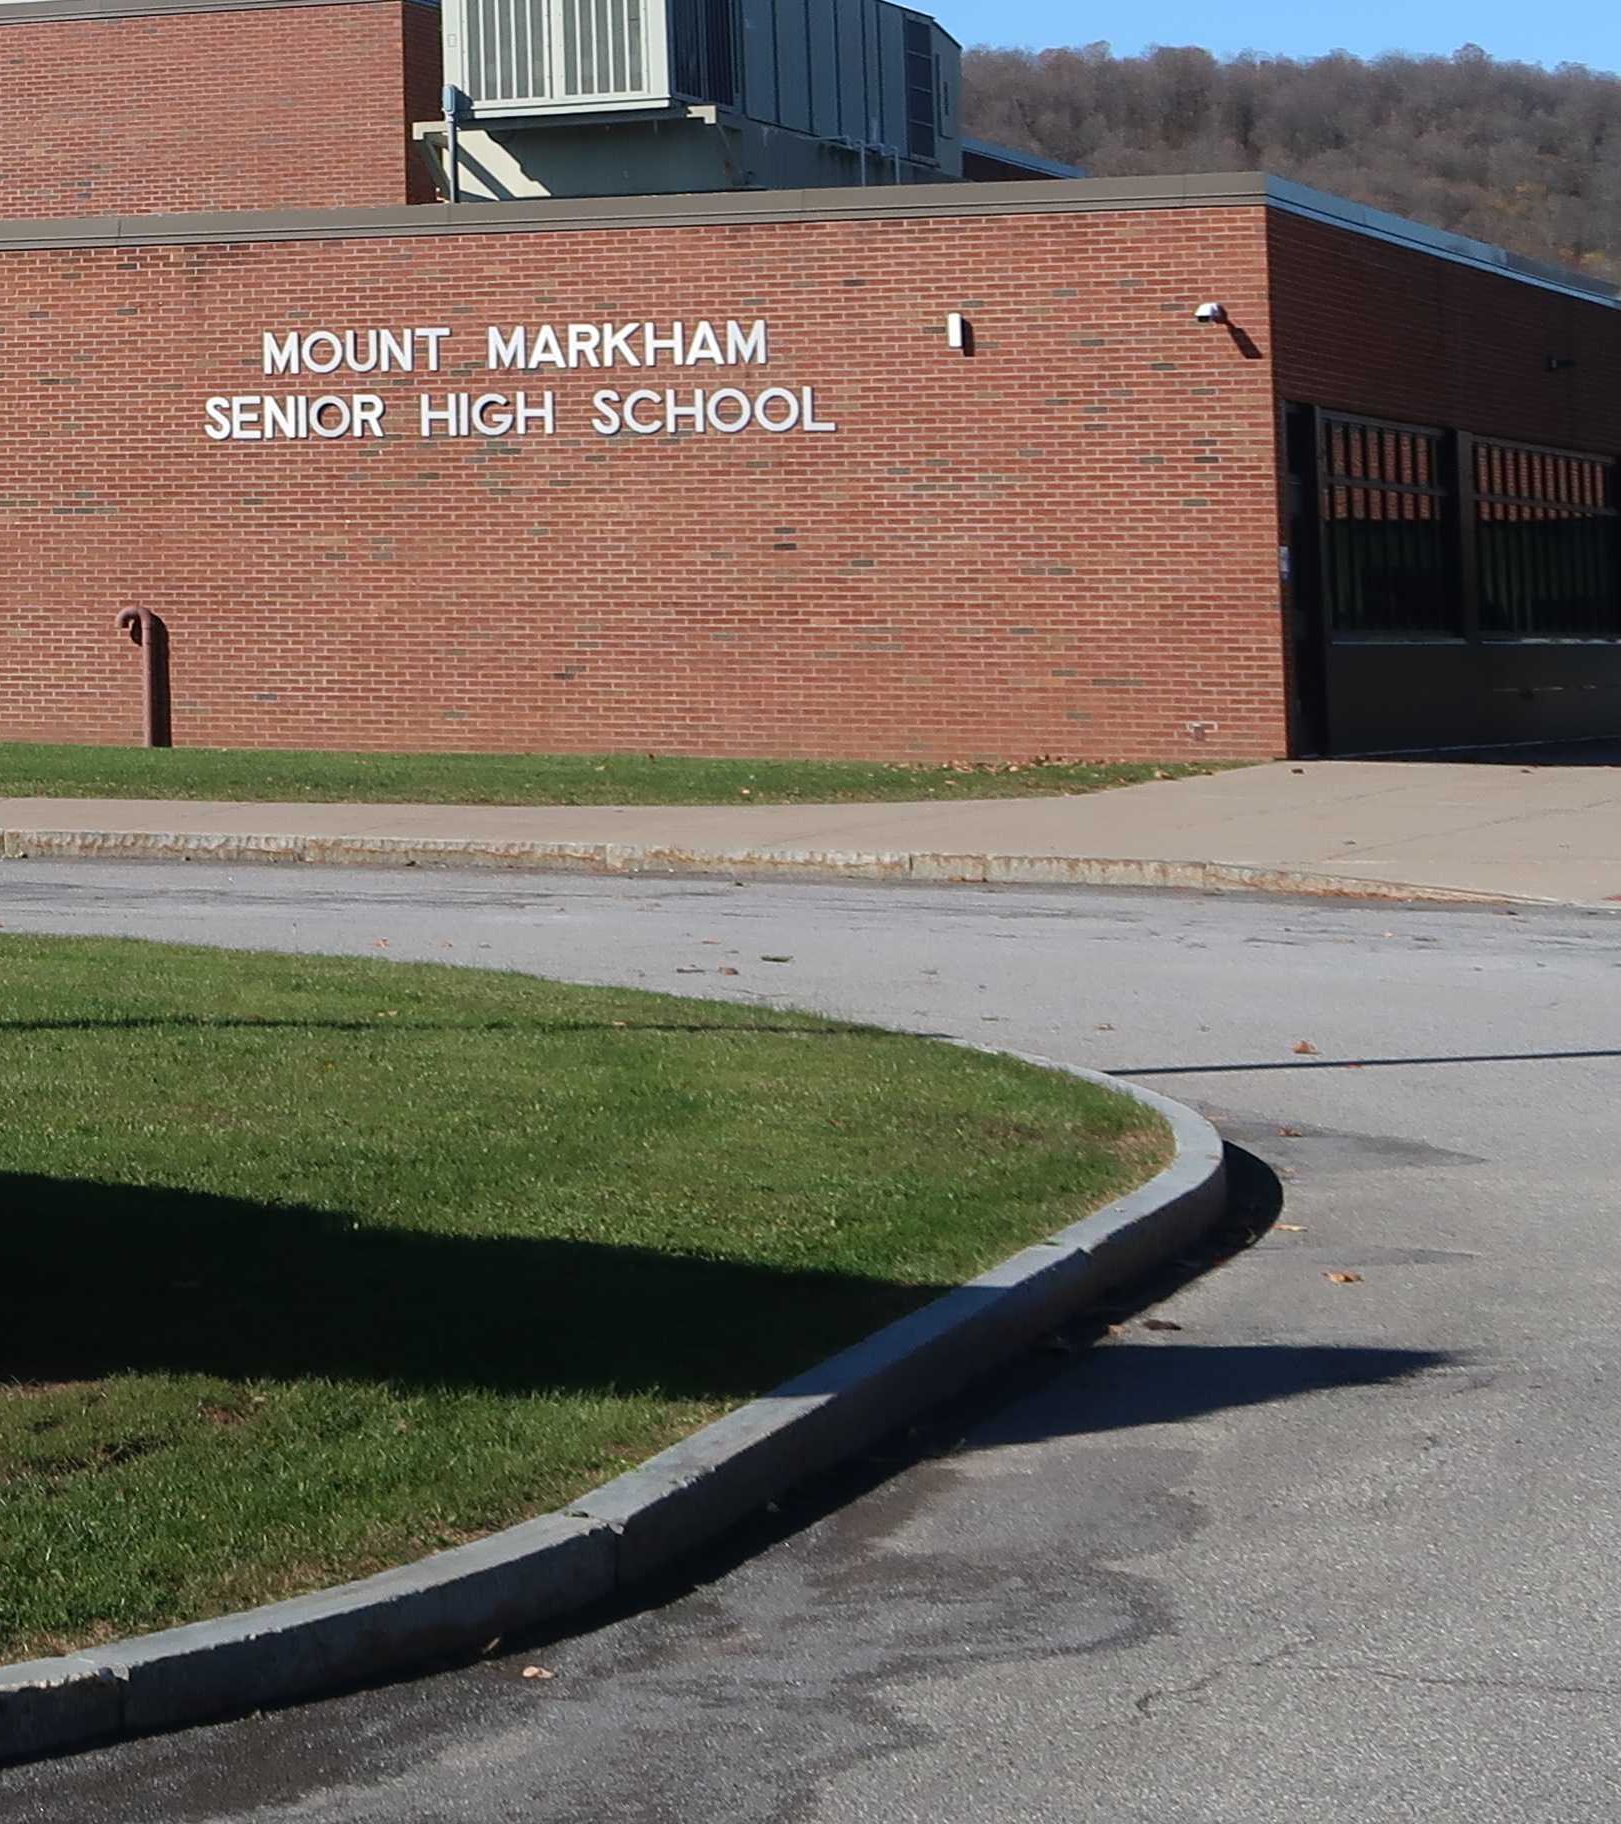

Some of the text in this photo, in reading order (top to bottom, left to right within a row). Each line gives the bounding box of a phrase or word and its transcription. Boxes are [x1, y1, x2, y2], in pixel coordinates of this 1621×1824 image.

[262, 318, 769, 375] MOUNT MARKHAM
[203, 385, 837, 441] SENIOR HIGH SCHOOL
